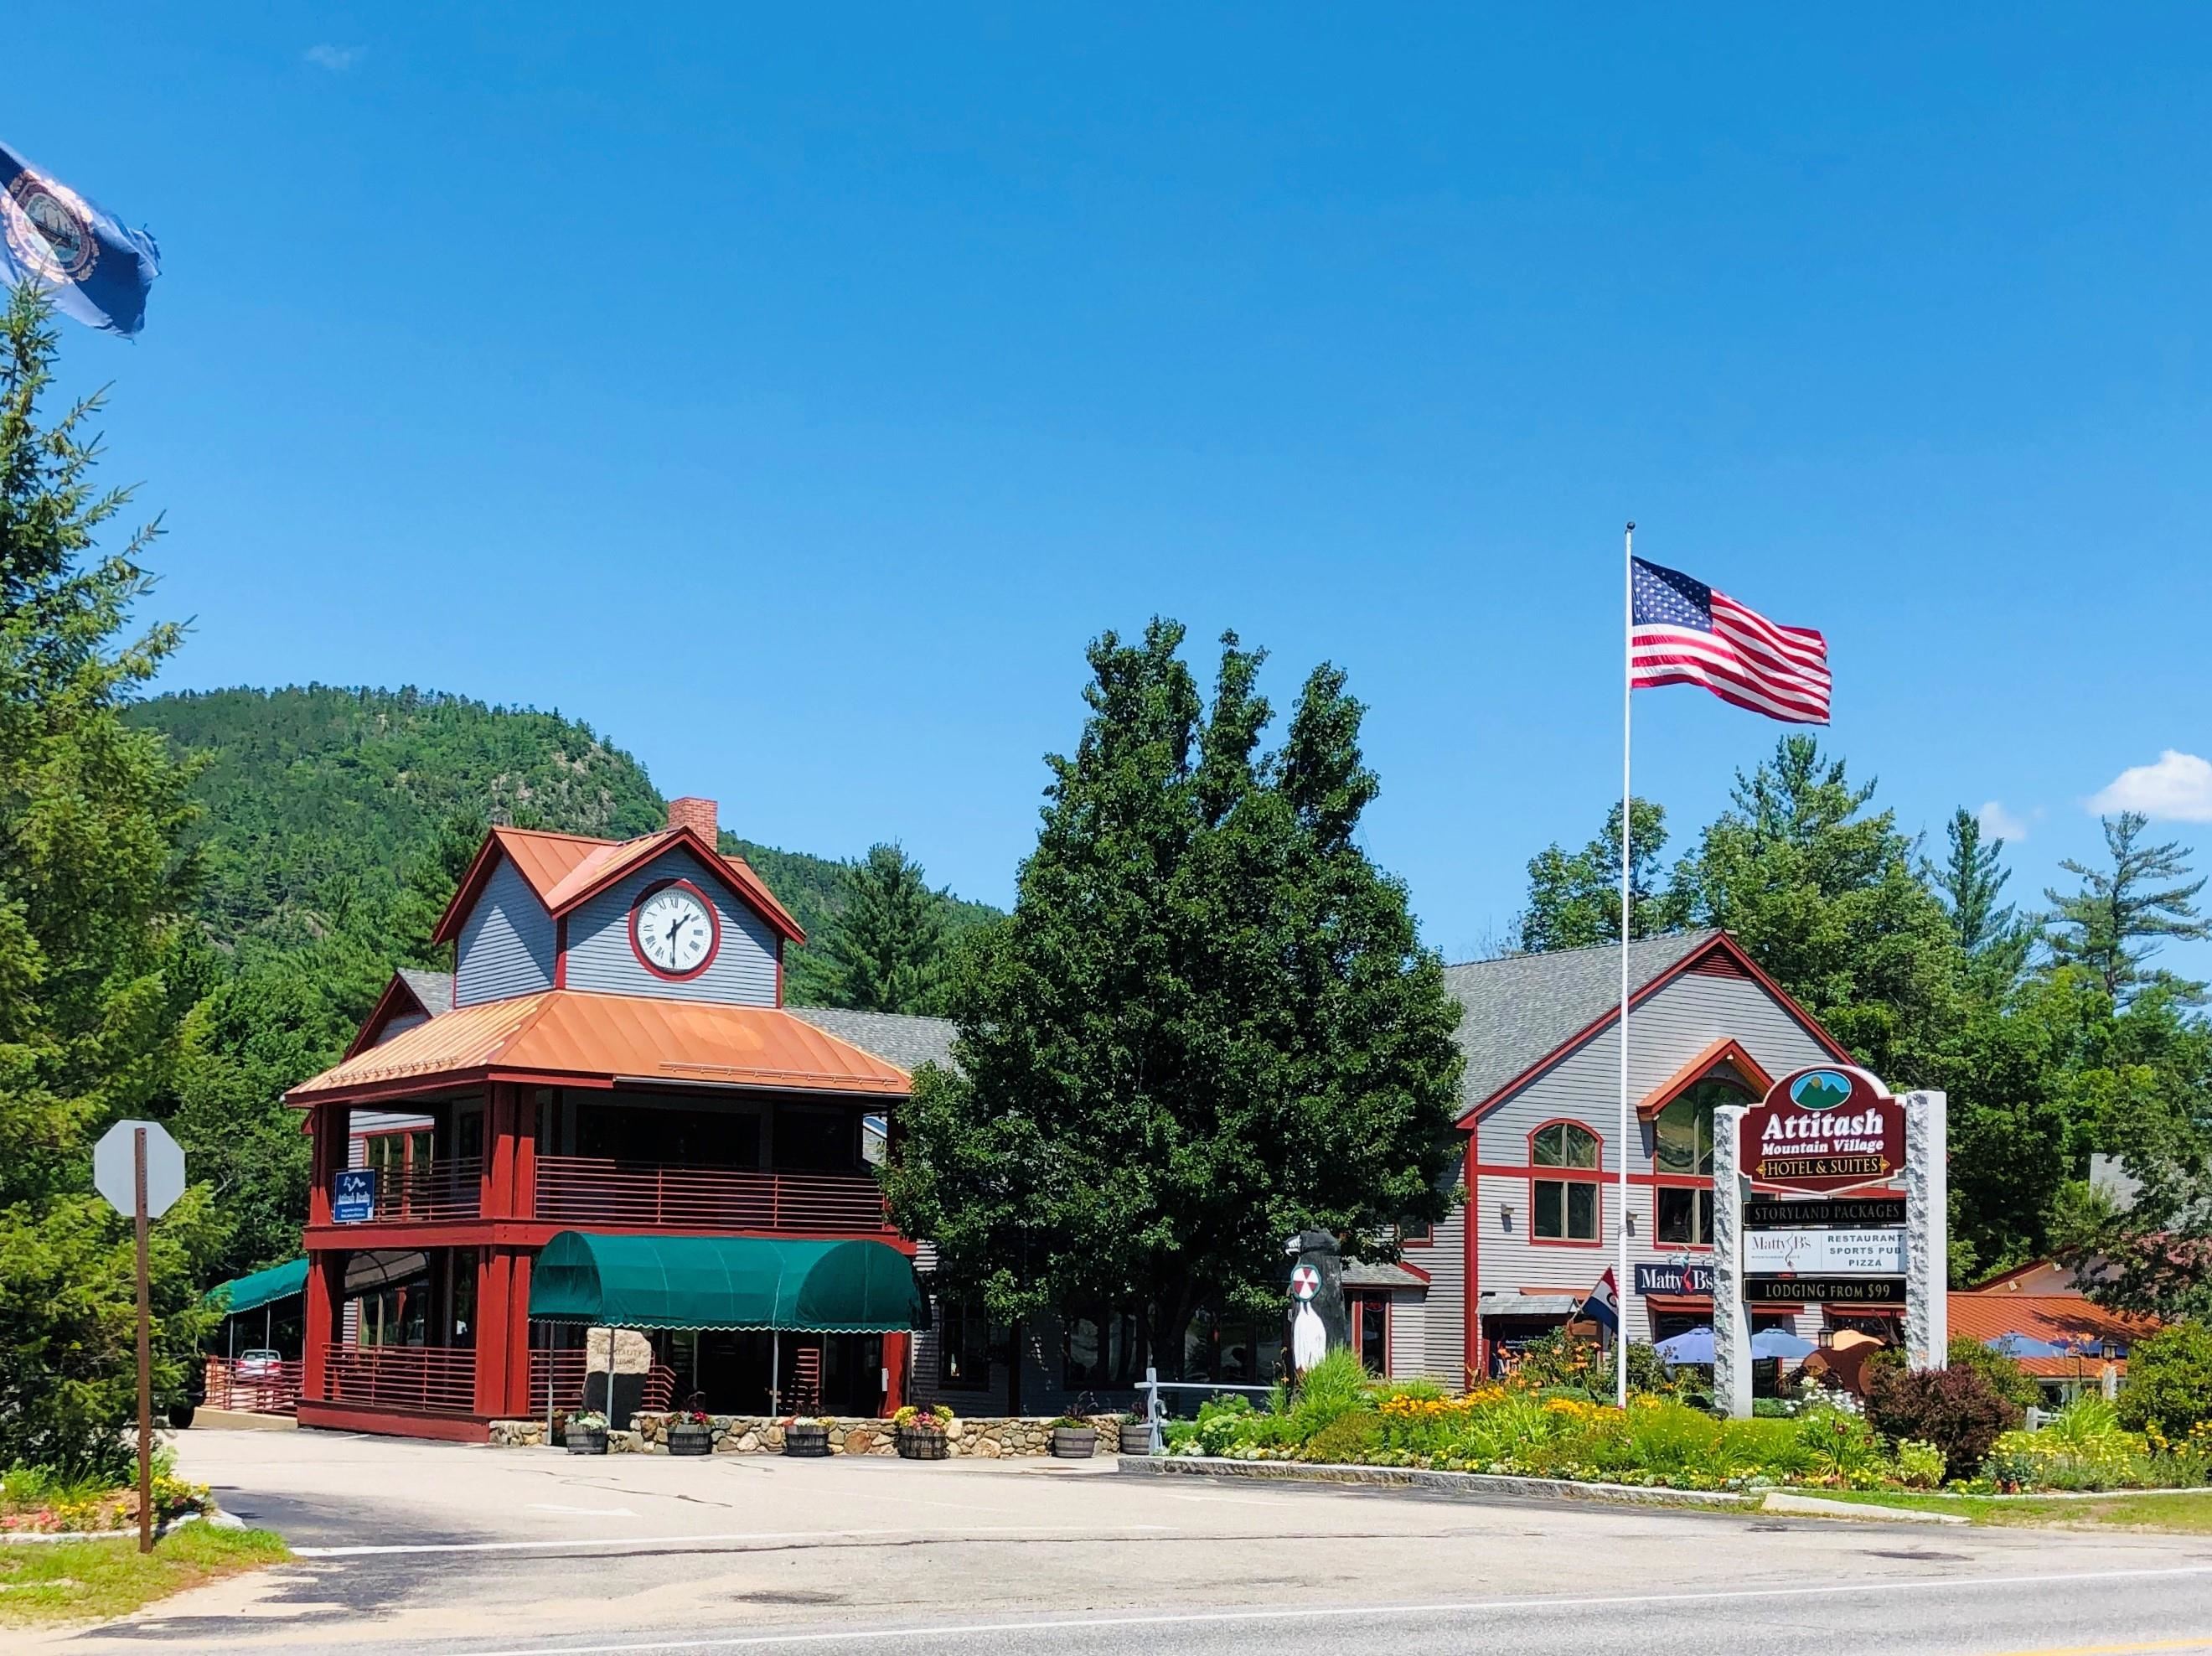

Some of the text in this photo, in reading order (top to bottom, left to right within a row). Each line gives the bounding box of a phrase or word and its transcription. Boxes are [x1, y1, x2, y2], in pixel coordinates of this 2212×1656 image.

[1761, 1107, 1884, 1141] Attitash
[1761, 1138, 1884, 1156] Mountain Village
[1767, 1157, 1878, 1176] HOTEL & SUITES
[1755, 1203, 1899, 1220] STORYLAND PACKAGES
[1827, 1234, 1903, 1243] RESTAURANT
[1879, 1246, 1901, 1255] PUB
[1640, 1268, 1713, 1292] Matty B's
[1765, 1283, 1890, 1298] LODGING FROM $99
